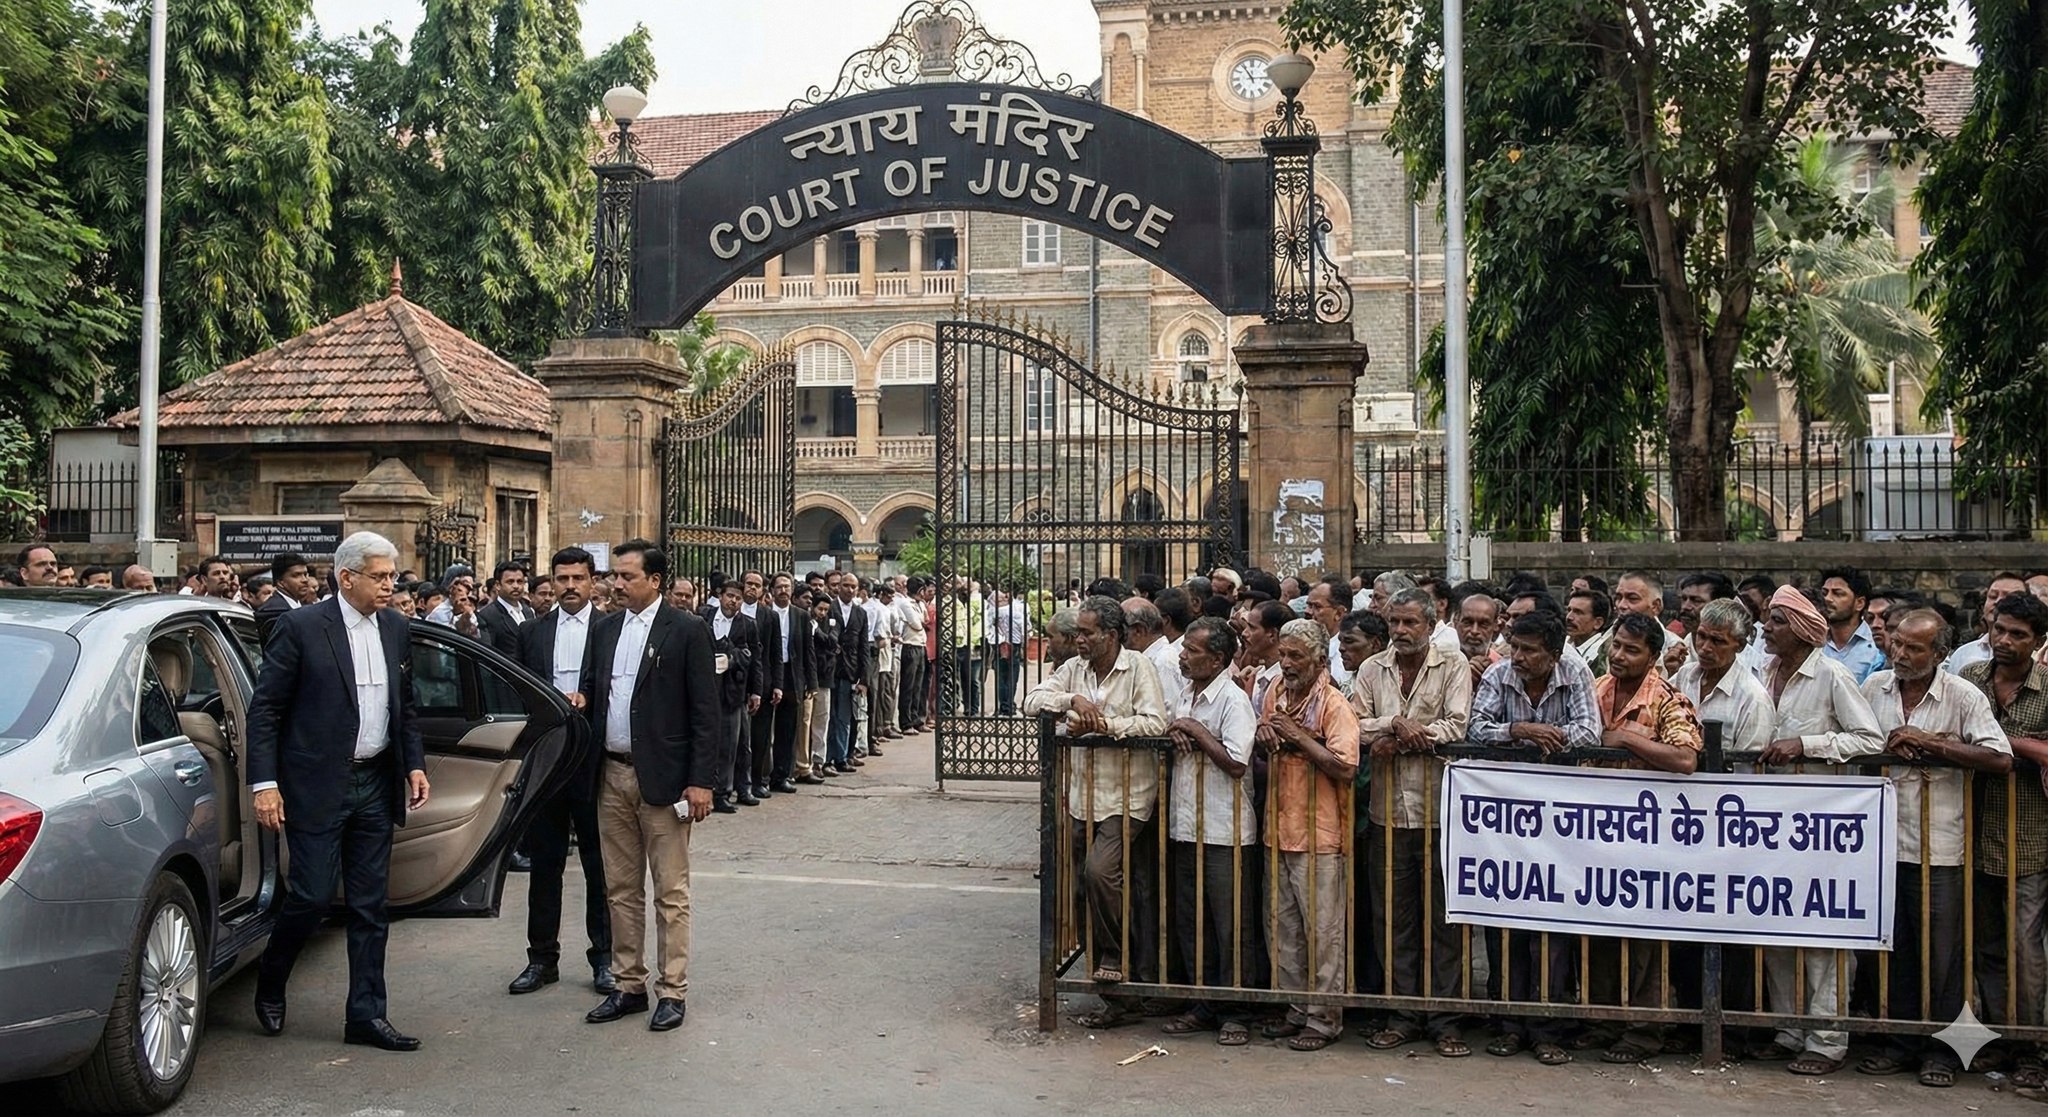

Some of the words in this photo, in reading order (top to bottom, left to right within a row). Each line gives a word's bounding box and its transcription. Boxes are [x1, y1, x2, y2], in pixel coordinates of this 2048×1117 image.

[783, 105, 922, 160] न्याय
[946, 92, 1095, 160] मंदिर
[708, 168, 860, 260] COURT
[883, 156, 947, 197] OF
[968, 158, 1175, 249] JUSTICE
[1553, 789, 1661, 844] जासदी
[1671, 792, 1707, 846] के
[1716, 793, 1782, 850] किर
[1788, 812, 1868, 853] आल
[1458, 856, 1565, 903] EQUAL
[1575, 866, 1715, 914] JUSTICE
[1727, 875, 1794, 917] FOR
[1802, 878, 1866, 920] ALL
